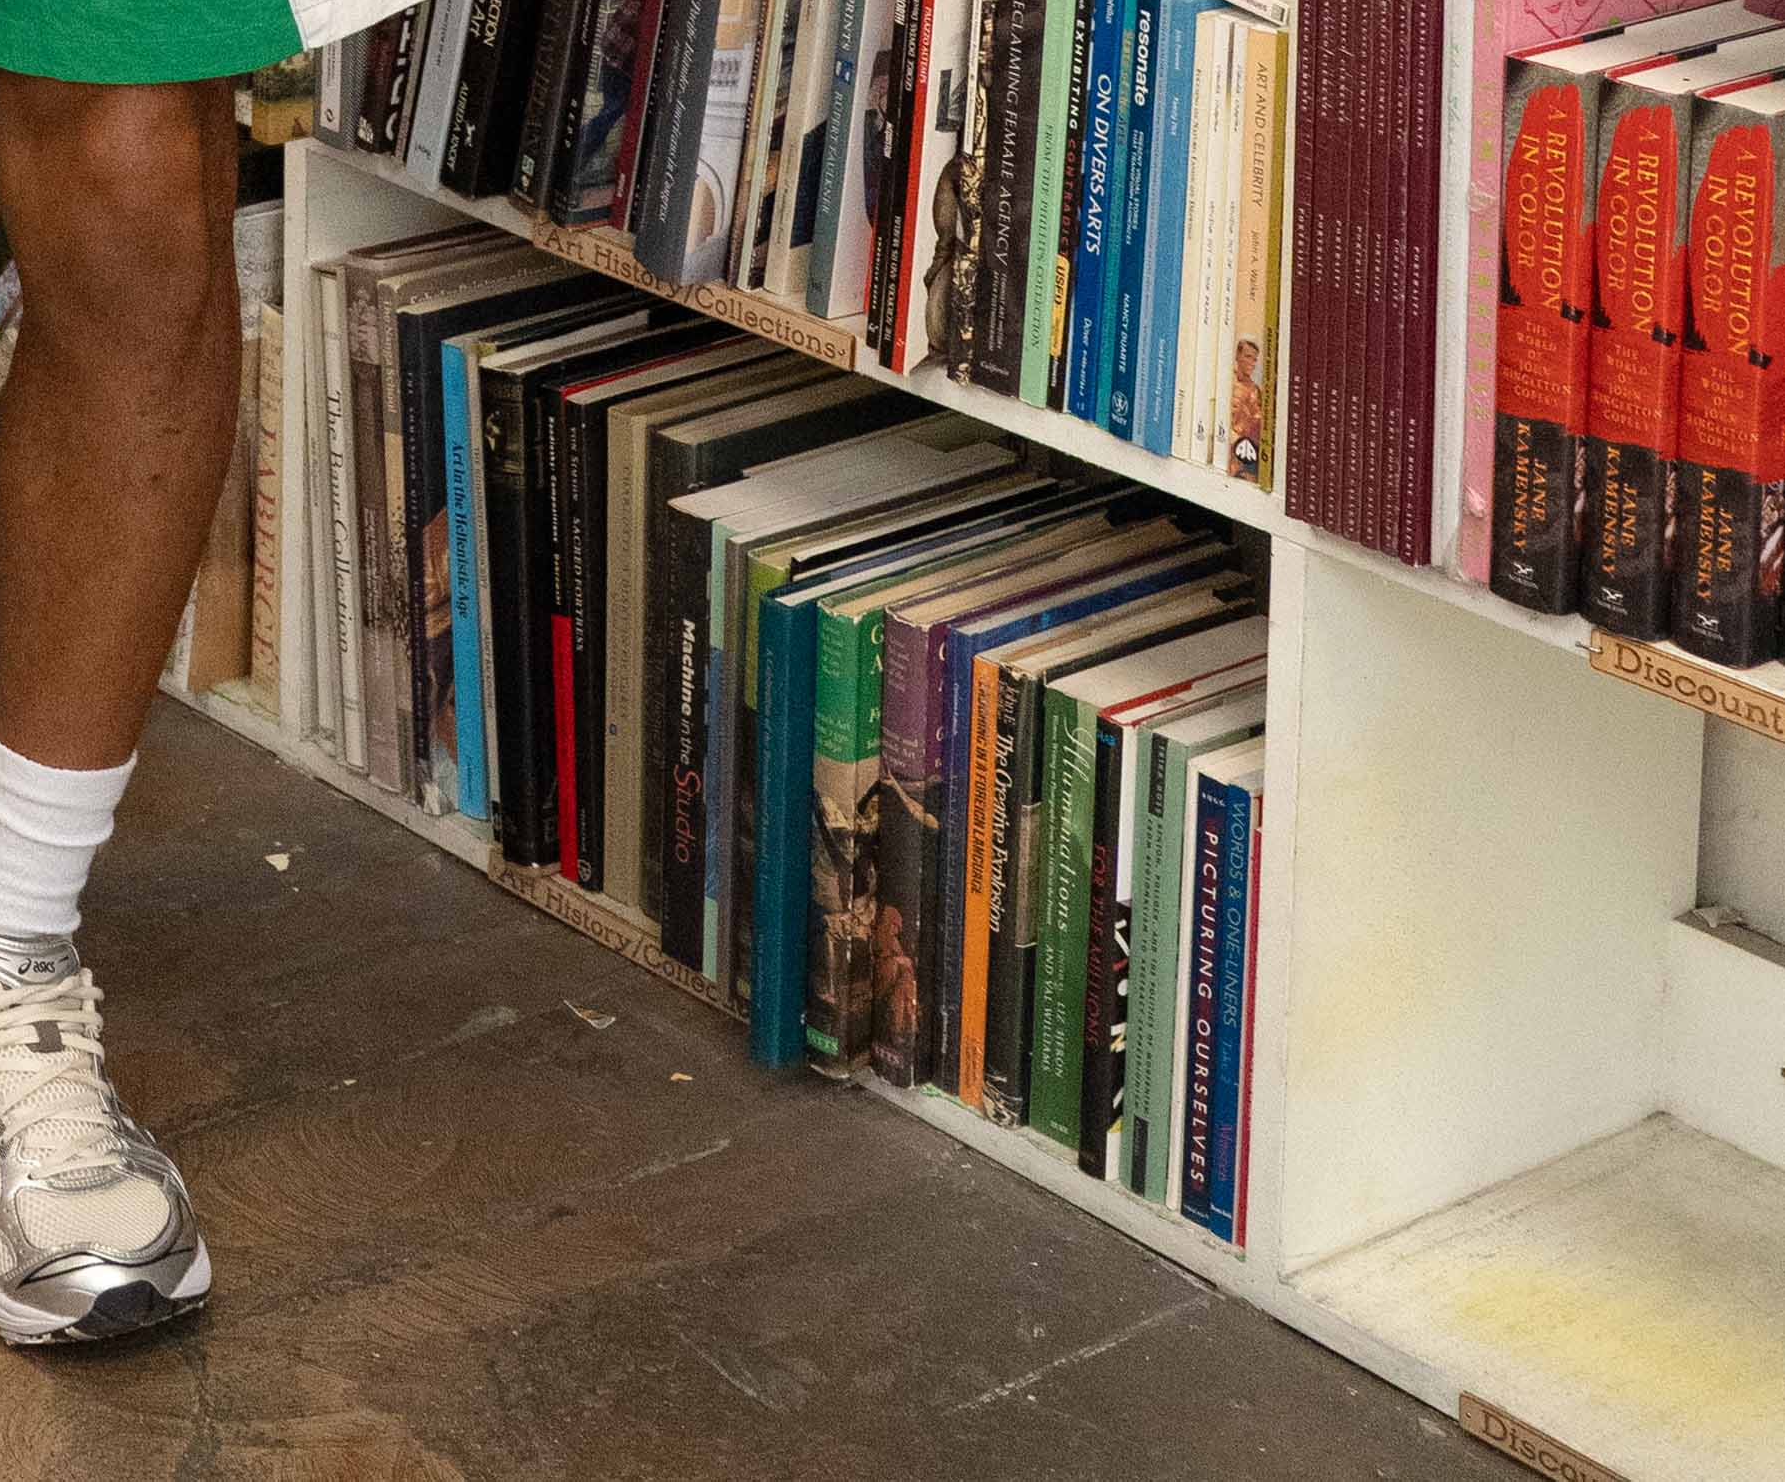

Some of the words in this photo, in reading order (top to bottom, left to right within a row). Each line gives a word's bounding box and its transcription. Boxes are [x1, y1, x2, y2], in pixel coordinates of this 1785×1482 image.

[1097, 74, 1113, 114] ON
[1134, 10, 1151, 107] resonate
[1522, 133, 1536, 164] IN
[1549, 103, 1562, 124] A
[1641, 129, 1656, 147] A
[1091, 121, 1110, 198] DIVERS
[1613, 154, 1625, 187] IN
[1708, 174, 1721, 207] IN
[1738, 147, 1754, 164] A
[1084, 200, 1103, 256] ARTS
[1517, 172, 1535, 270] COLOR
[1541, 131, 1567, 313] REVOLUTION
[1608, 194, 1625, 292] COLOR
[1633, 152, 1661, 336] REVOLUTION
[545, 226, 587, 257] Art
[592, 243, 837, 360] History/Collections
[1702, 214, 1721, 312] COLOR
[1727, 171, 1757, 359] REVOLUTION
[450, 440, 463, 469] Art
[1513, 421, 1531, 550] KAMENSKY
[1531, 462, 1548, 523] JANE
[454, 507, 469, 590] Hellenistic
[573, 516, 583, 572] SACRED
[1600, 446, 1618, 576] KAMENSKY
[1621, 483, 1638, 547] JANE
[1697, 469, 1713, 602] KAMENSKY
[1716, 508, 1733, 572] JANE
[457, 591, 469, 621] Age
[575, 573, 585, 653] FORTRESS
[1613, 650, 1784, 736] Discount
[545, 887, 725, 1005] History/Collec
[1192, 829, 1220, 1000] PICTURING
[1187, 1018, 1213, 1184] OURSELVES
